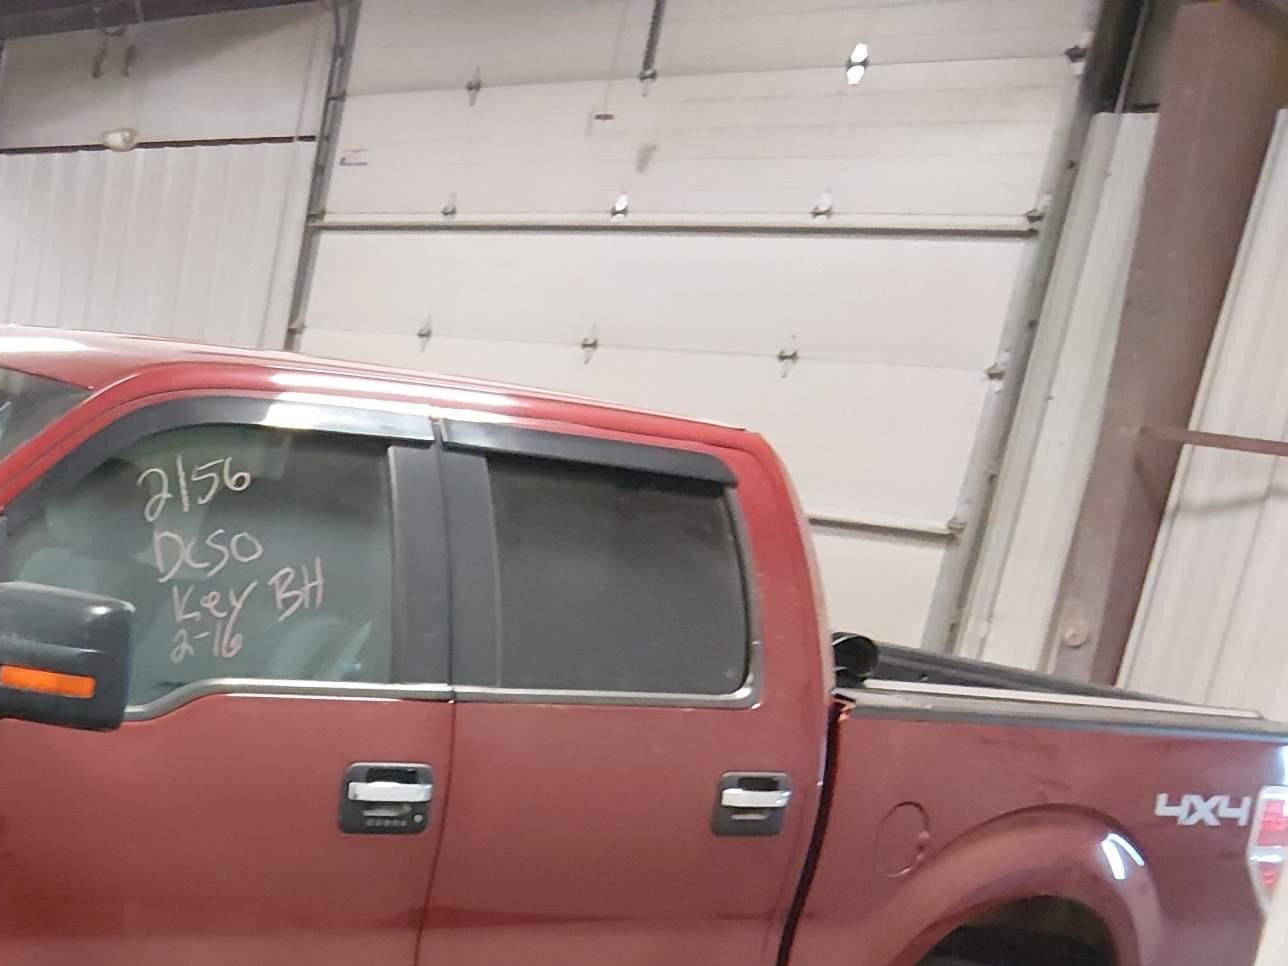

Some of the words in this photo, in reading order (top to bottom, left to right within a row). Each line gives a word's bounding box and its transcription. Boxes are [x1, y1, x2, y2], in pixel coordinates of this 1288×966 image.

[136, 453, 251, 523] 2156
[267, 556, 325, 621] BH
[169, 624, 244, 664] 2-16
